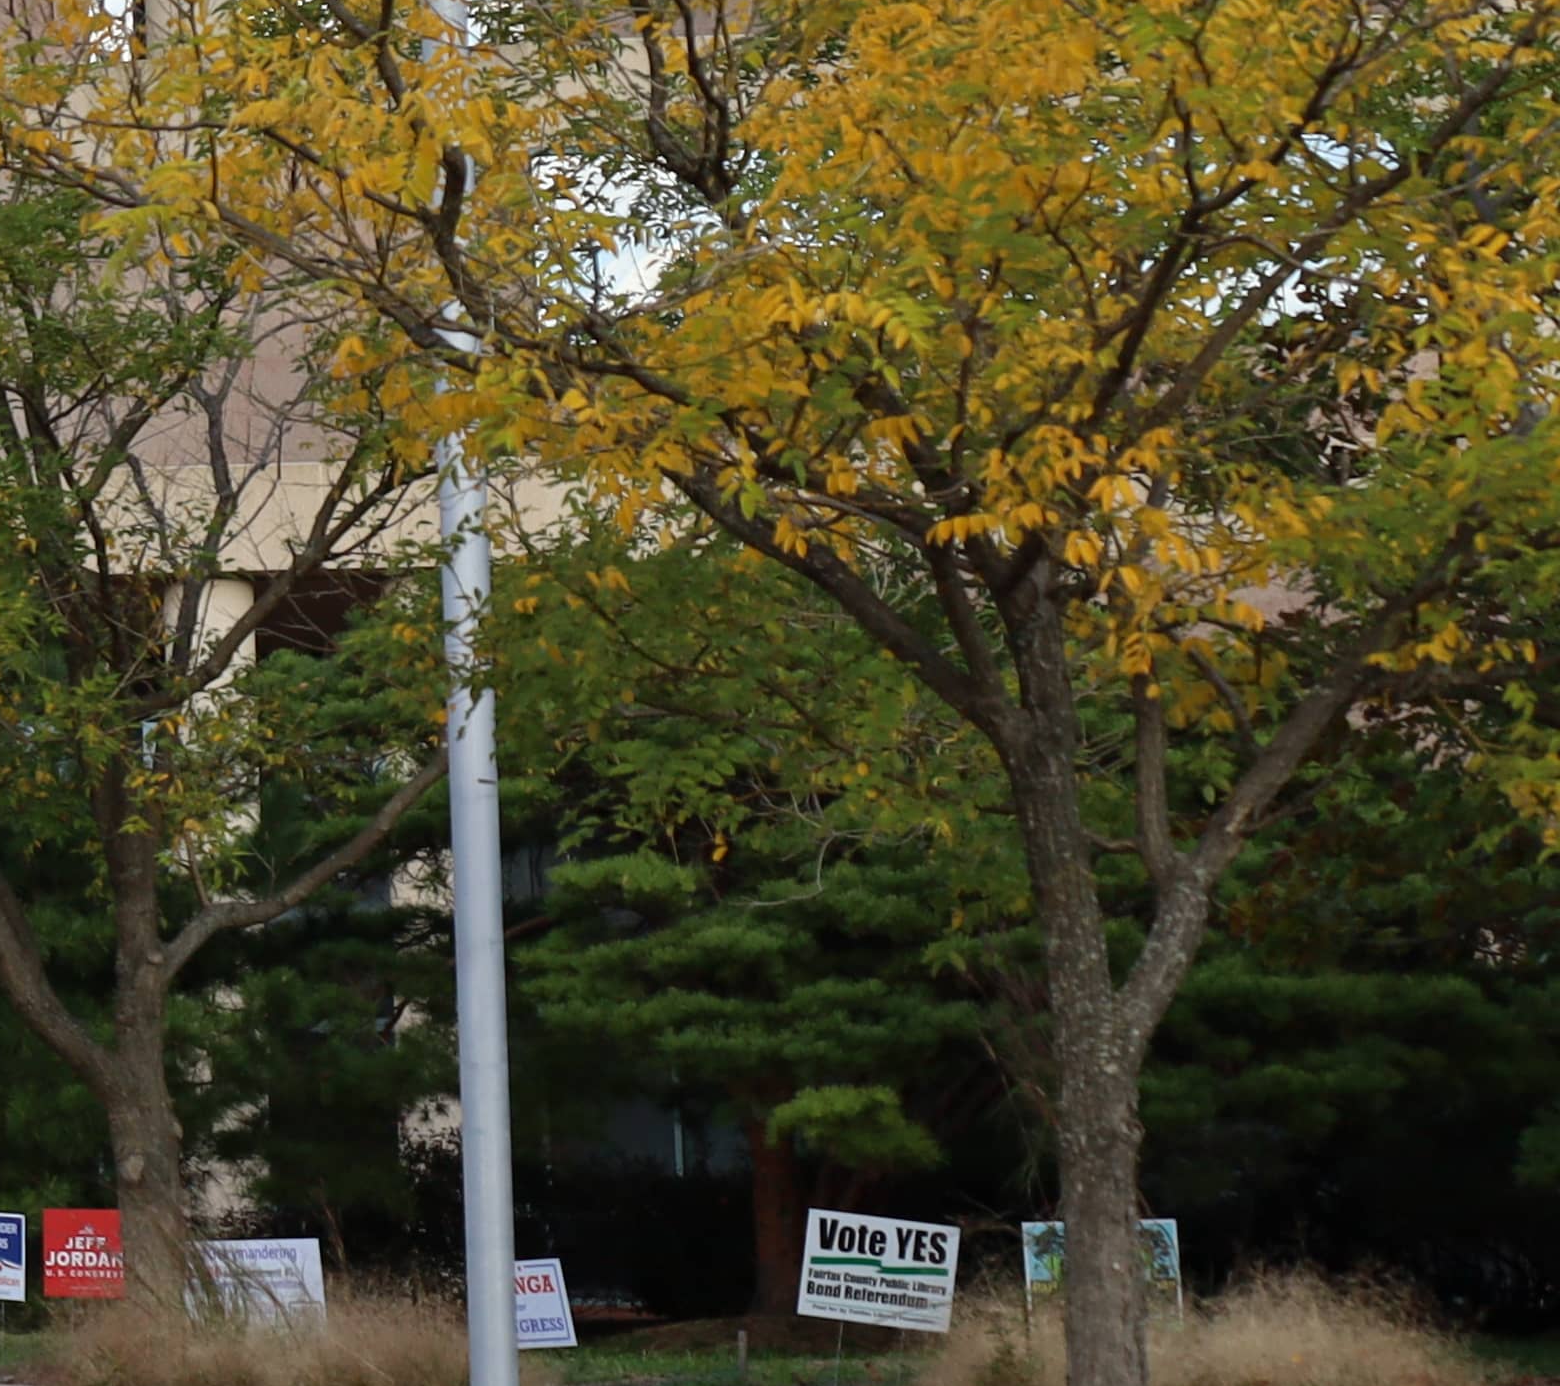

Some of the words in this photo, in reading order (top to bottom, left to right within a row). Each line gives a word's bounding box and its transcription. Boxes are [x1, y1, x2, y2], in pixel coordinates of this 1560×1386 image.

[65, 1237, 106, 1249] JEFF
[818, 1217, 888, 1257] Vote
[896, 1227, 948, 1265] YES
[44, 1251, 124, 1268] JORDAN
[514, 1274, 556, 1295] NGA
[808, 1268, 841, 1282] Fairfax
[843, 1272, 877, 1287] County
[879, 1277, 910, 1291] Public
[912, 1281, 947, 1296] Library
[806, 1281, 841, 1298] Bond
[844, 1285, 929, 1310] Referendum
[519, 1317, 565, 1333] GRESS
